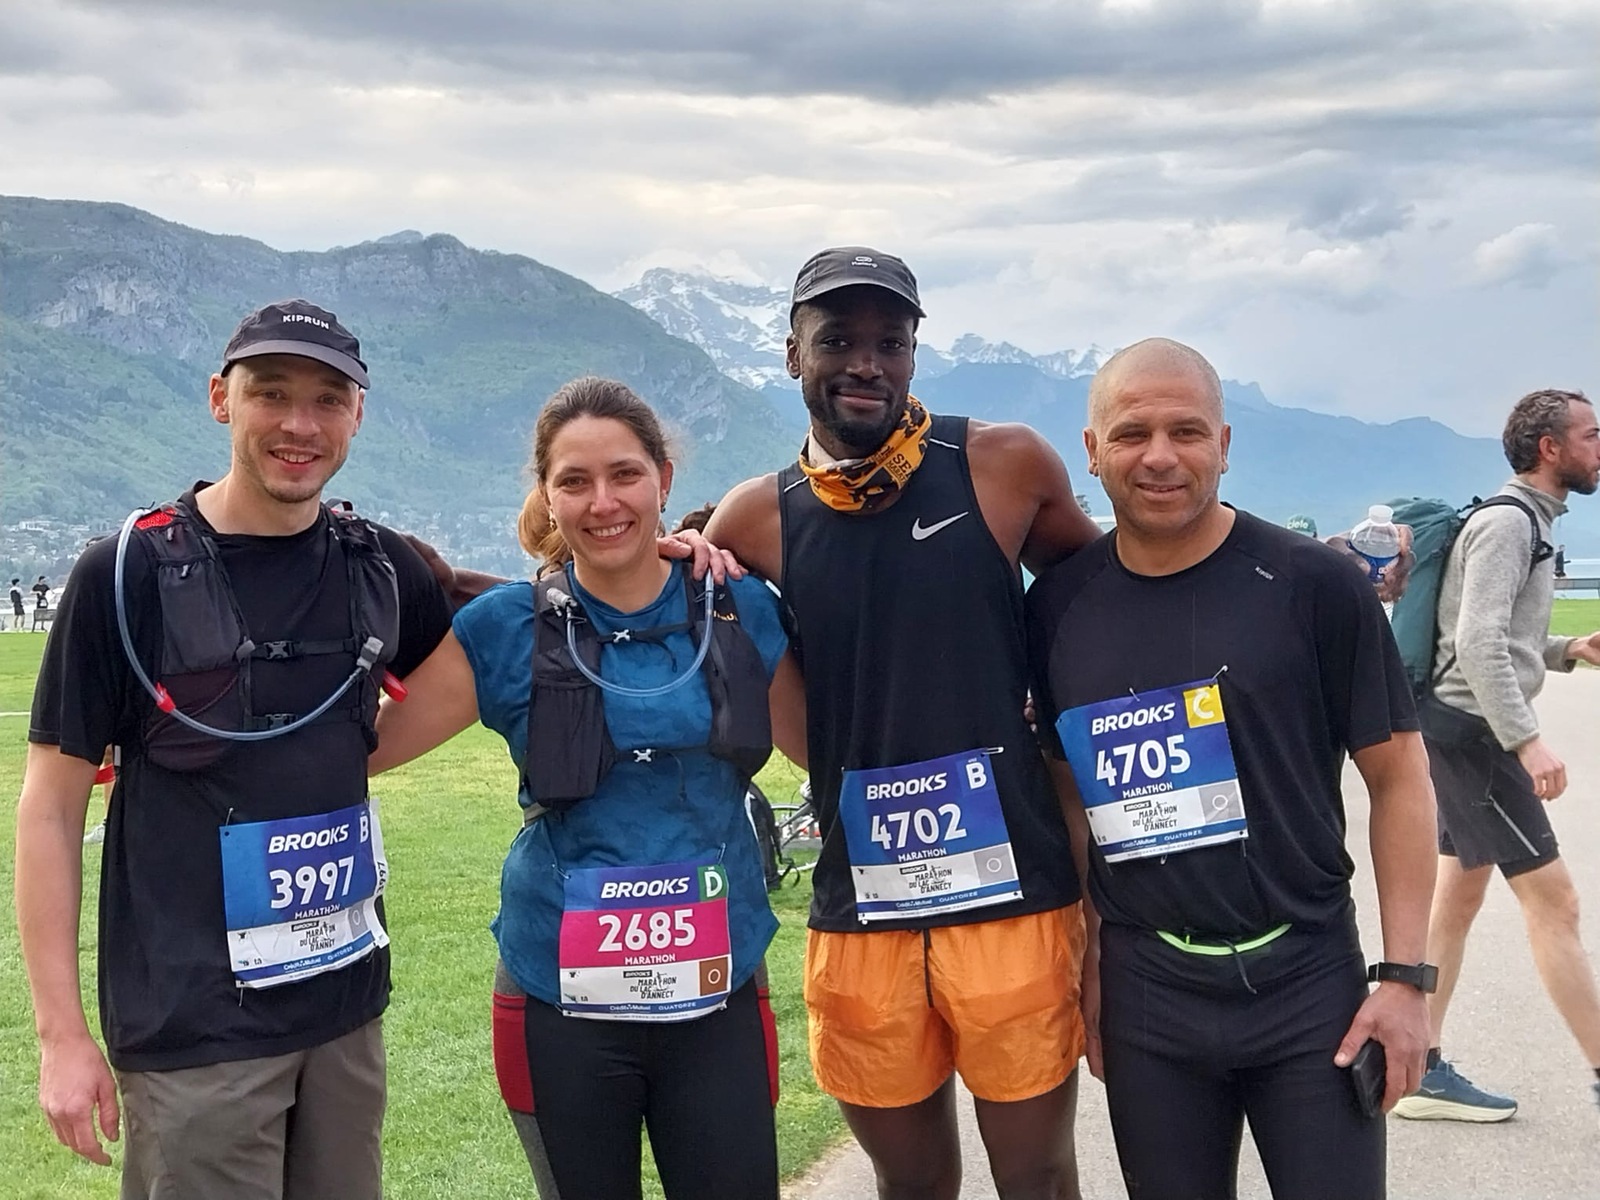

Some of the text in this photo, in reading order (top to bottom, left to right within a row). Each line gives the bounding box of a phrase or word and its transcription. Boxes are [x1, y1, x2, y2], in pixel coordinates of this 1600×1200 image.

[283, 314, 330, 330] KIPRUN
[1091, 702, 1176, 736] BROOKS
[1192, 691, 1215, 719] C
[1095, 734, 1191, 787] 4705
[866, 772, 947, 801] BROOKS
[965, 761, 987, 790] B
[1122, 781, 1174, 799] MARATHON
[268, 823, 350, 854] BROOKS
[359, 815, 369, 843] B
[870, 803, 967, 850] 4702
[898, 847, 947, 863] MARATHON
[269, 855, 355, 909] 3997
[600, 876, 690, 899] BROOKS
[704, 870, 723, 898] D
[294, 903, 341, 920] MARATHON
[597, 908, 696, 953] 2685
[624, 953, 677, 966] MARATHON
[640, 990, 675, 999] D'ANNECY
